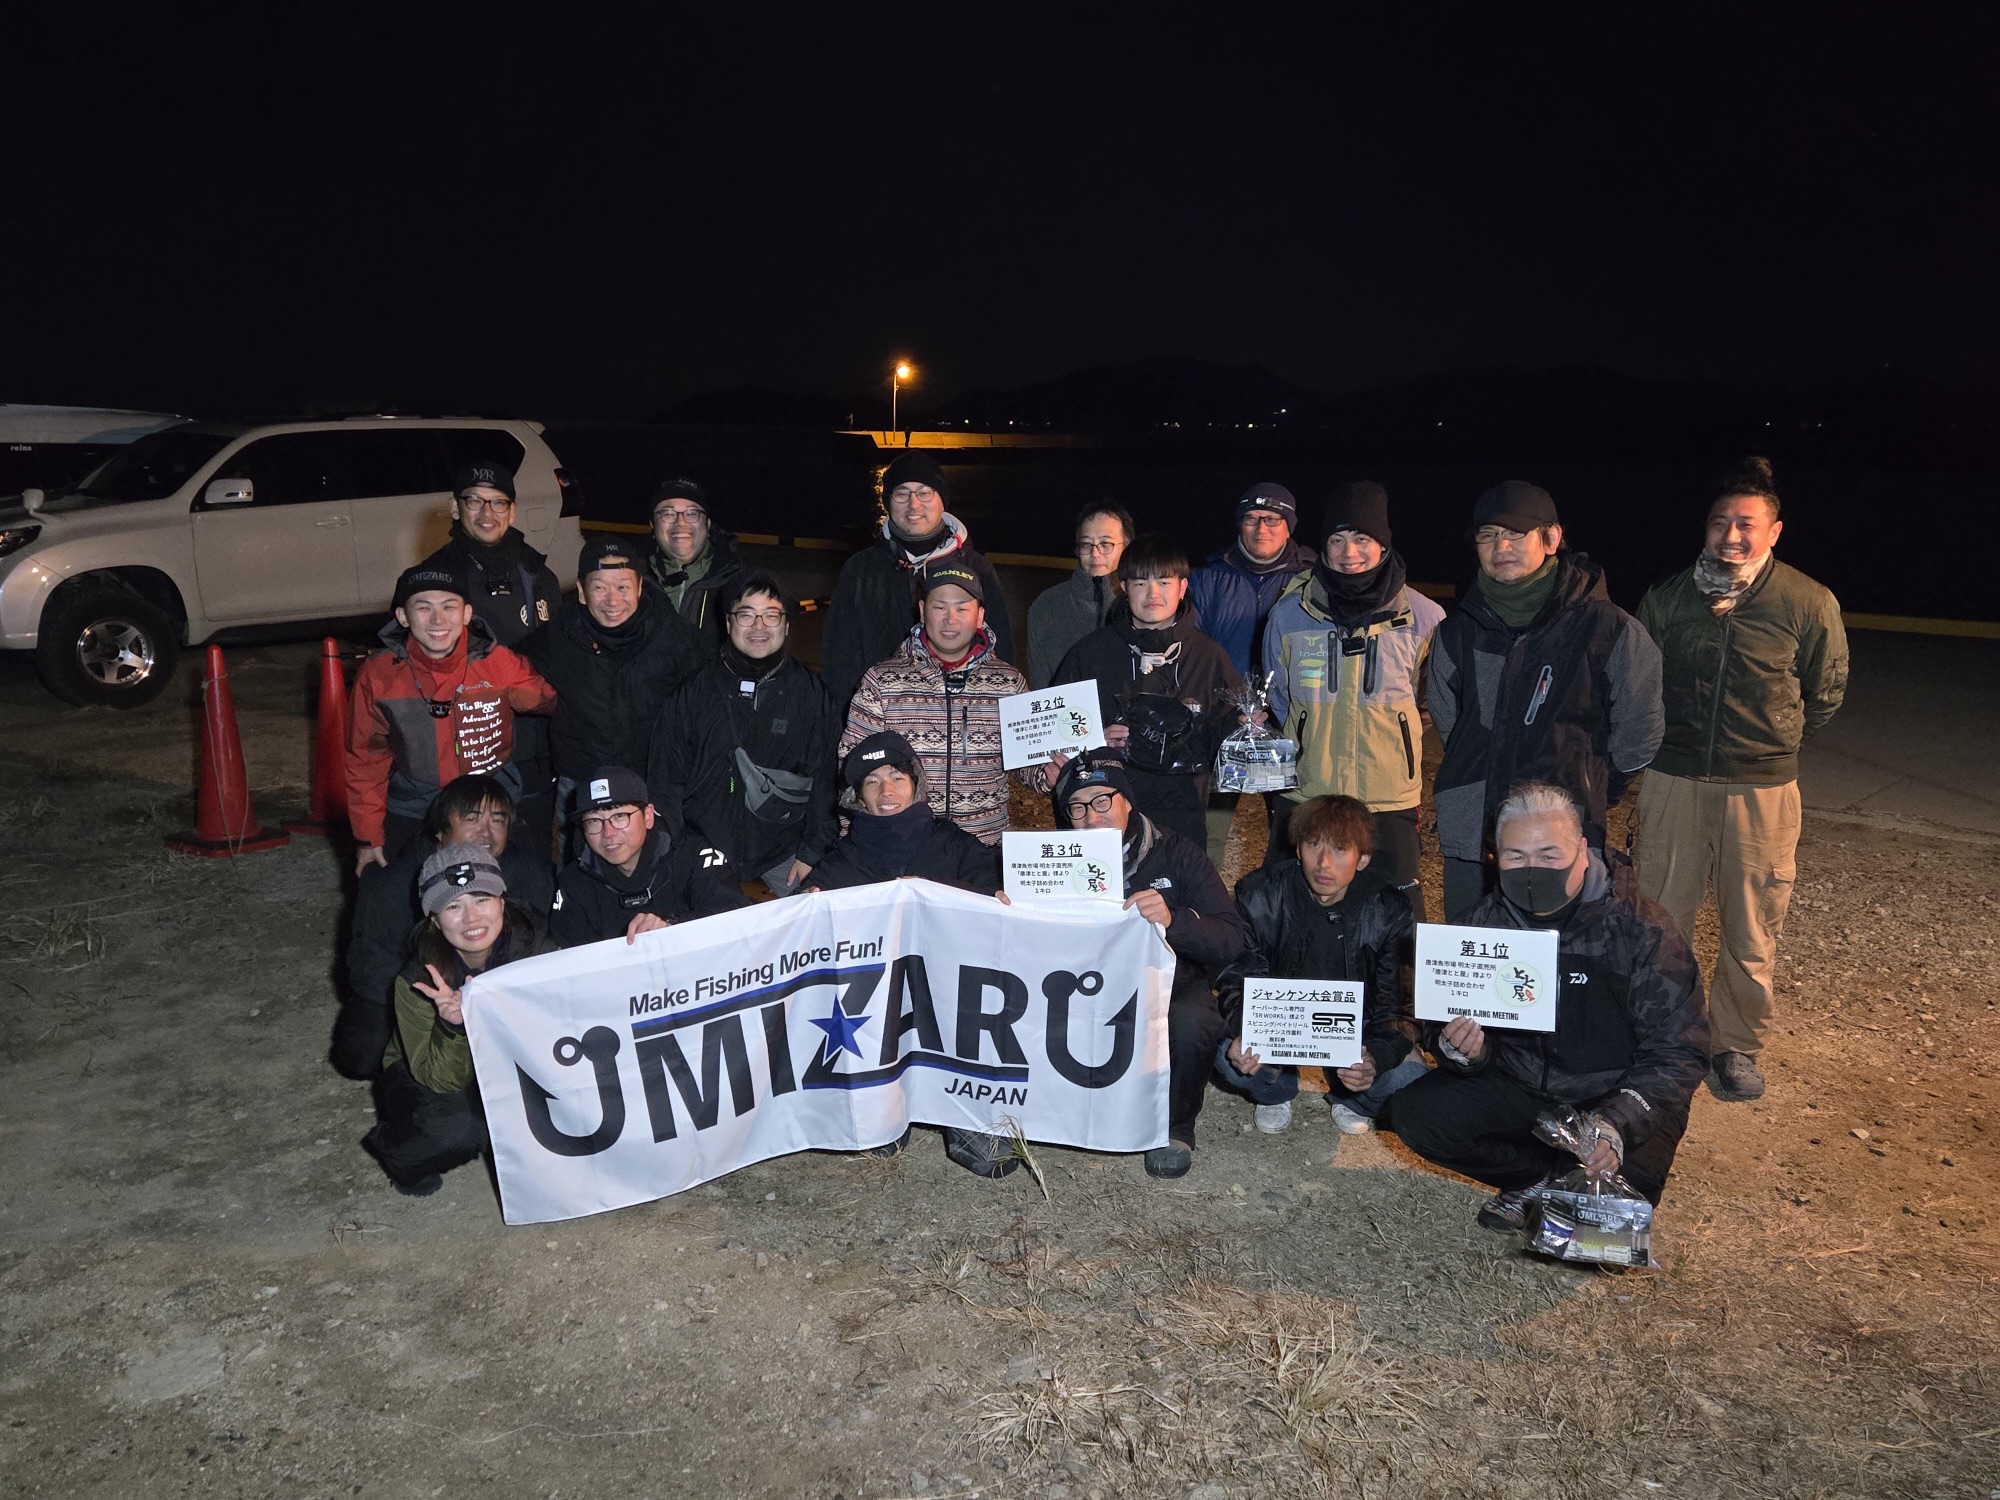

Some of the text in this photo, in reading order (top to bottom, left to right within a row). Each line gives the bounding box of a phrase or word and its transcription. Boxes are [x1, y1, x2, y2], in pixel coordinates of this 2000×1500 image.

[932, 569, 974, 581] OAKLEY
[462, 712, 500, 724] Adventure
[459, 729, 475, 738] you
[490, 718, 502, 729] take
[480, 735, 492, 744] live
[492, 730, 502, 739] the
[464, 748, 478, 759] Life
[479, 745, 488, 756] of
[488, 741, 502, 754] your
[1028, 751, 1046, 760] KAGAWA
[1060, 746, 1080, 754] MEETING
[472, 754, 496, 768] Dreams
[629, 936, 884, 1017] Make Fishing More Fun!
[1251, 988, 1357, 1003] ジャンケン大会賞品
[1312, 1012, 1356, 1028] SR
[1447, 1007, 1519, 1021] KAGAWA AJING MEETING
[1312, 1026, 1356, 1034] WORKS
[514, 954, 1139, 1156] UMIZARU
[1308, 1052, 1331, 1060] MEETING
[944, 1078, 1028, 1106] JAPAN
